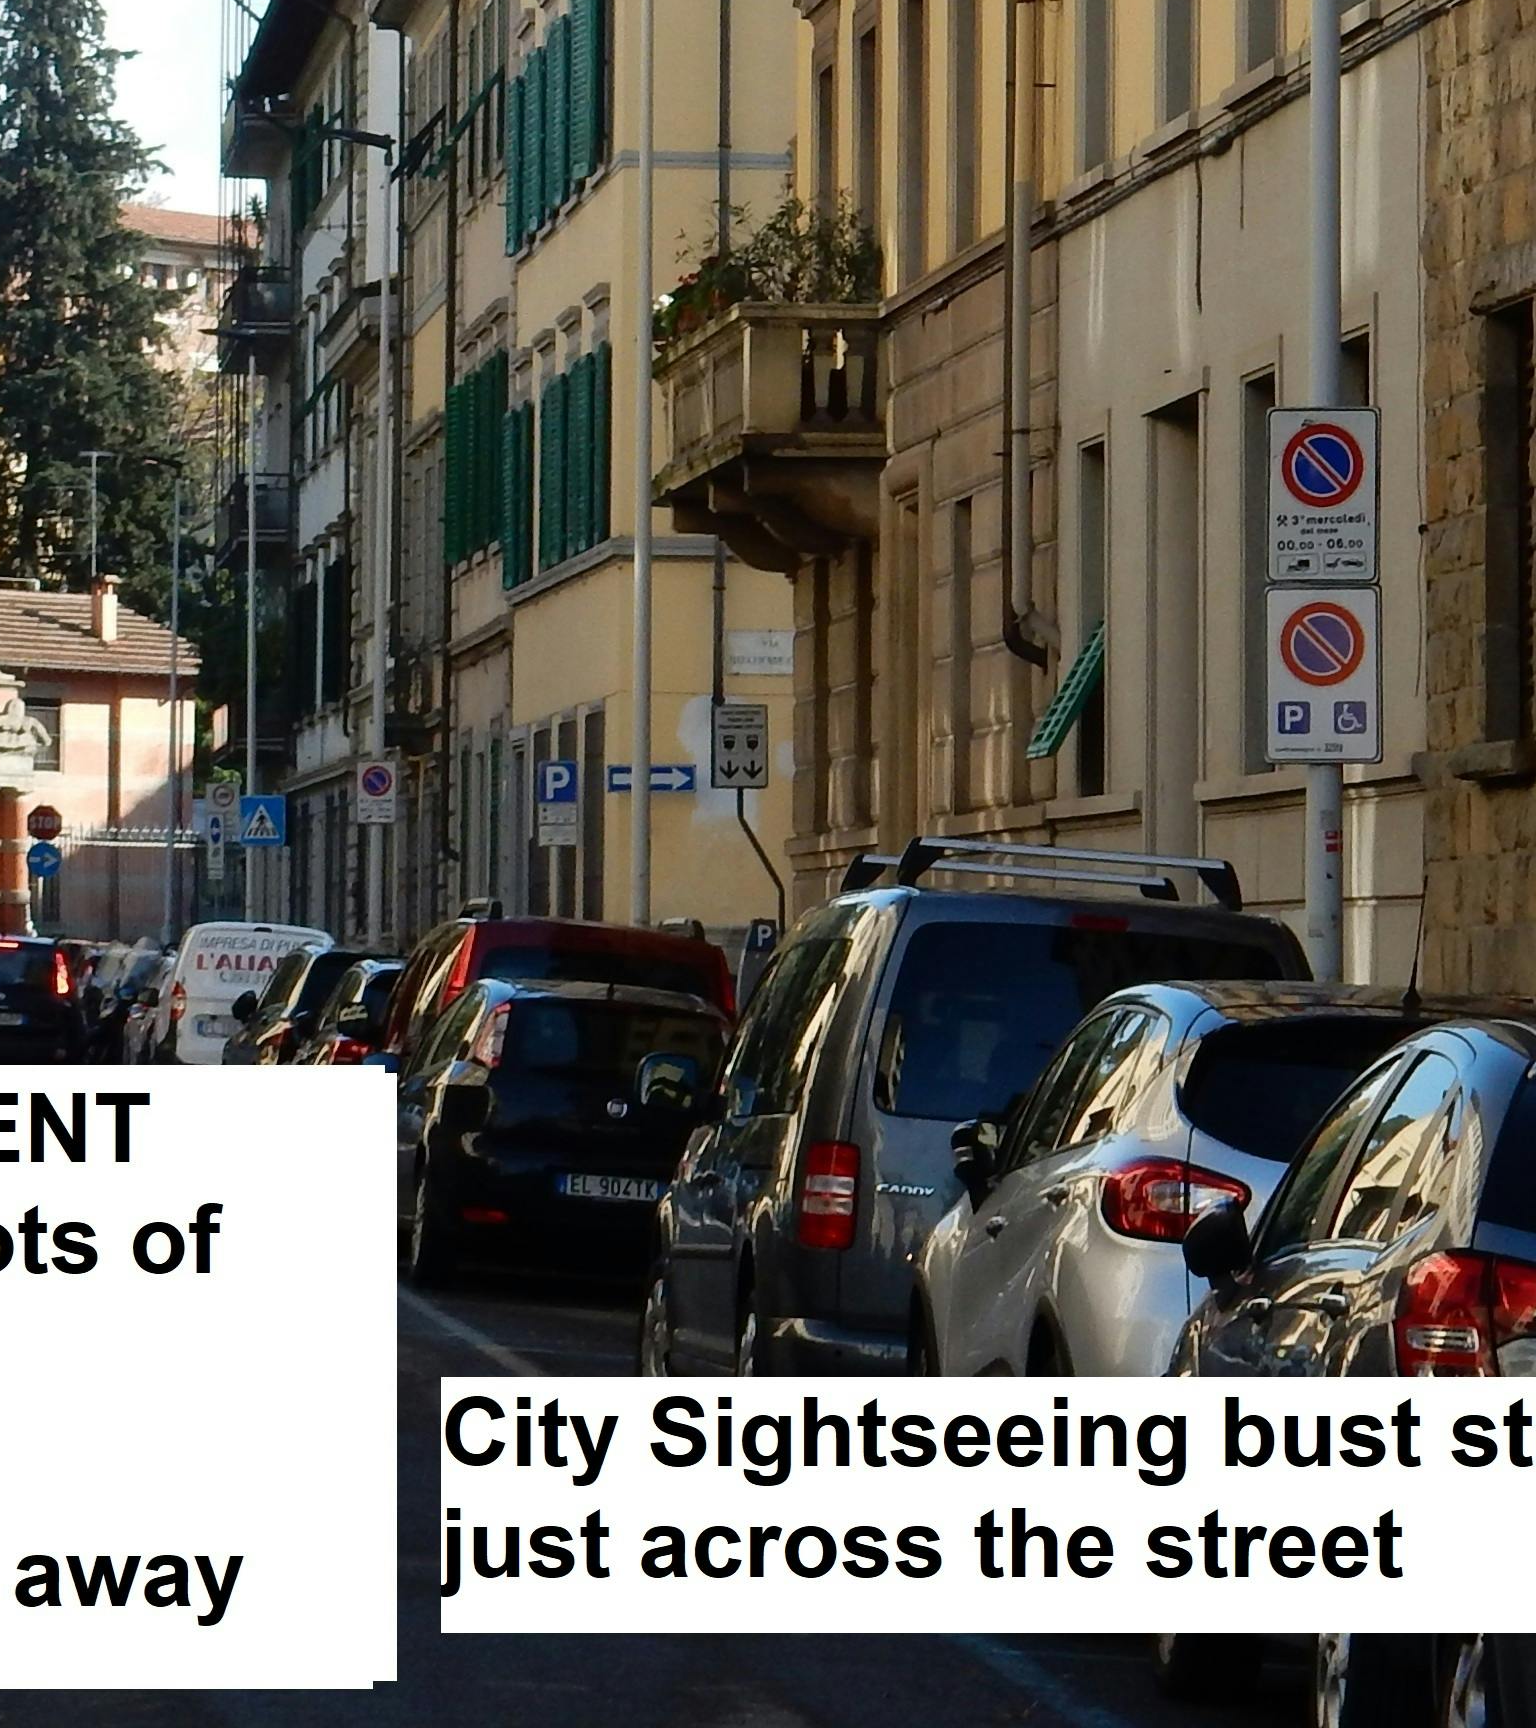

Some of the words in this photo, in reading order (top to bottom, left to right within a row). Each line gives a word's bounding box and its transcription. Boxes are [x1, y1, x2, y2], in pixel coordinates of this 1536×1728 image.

[1277, 539, 1314, 551] 00.00
[1284, 705, 1304, 731] P
[546, 765, 571, 800] P
[29, 815, 61, 830] STOP
[757, 924, 772, 947] P
[570, 1175, 591, 1194] EL
[875, 1183, 935, 1196] CADDY
